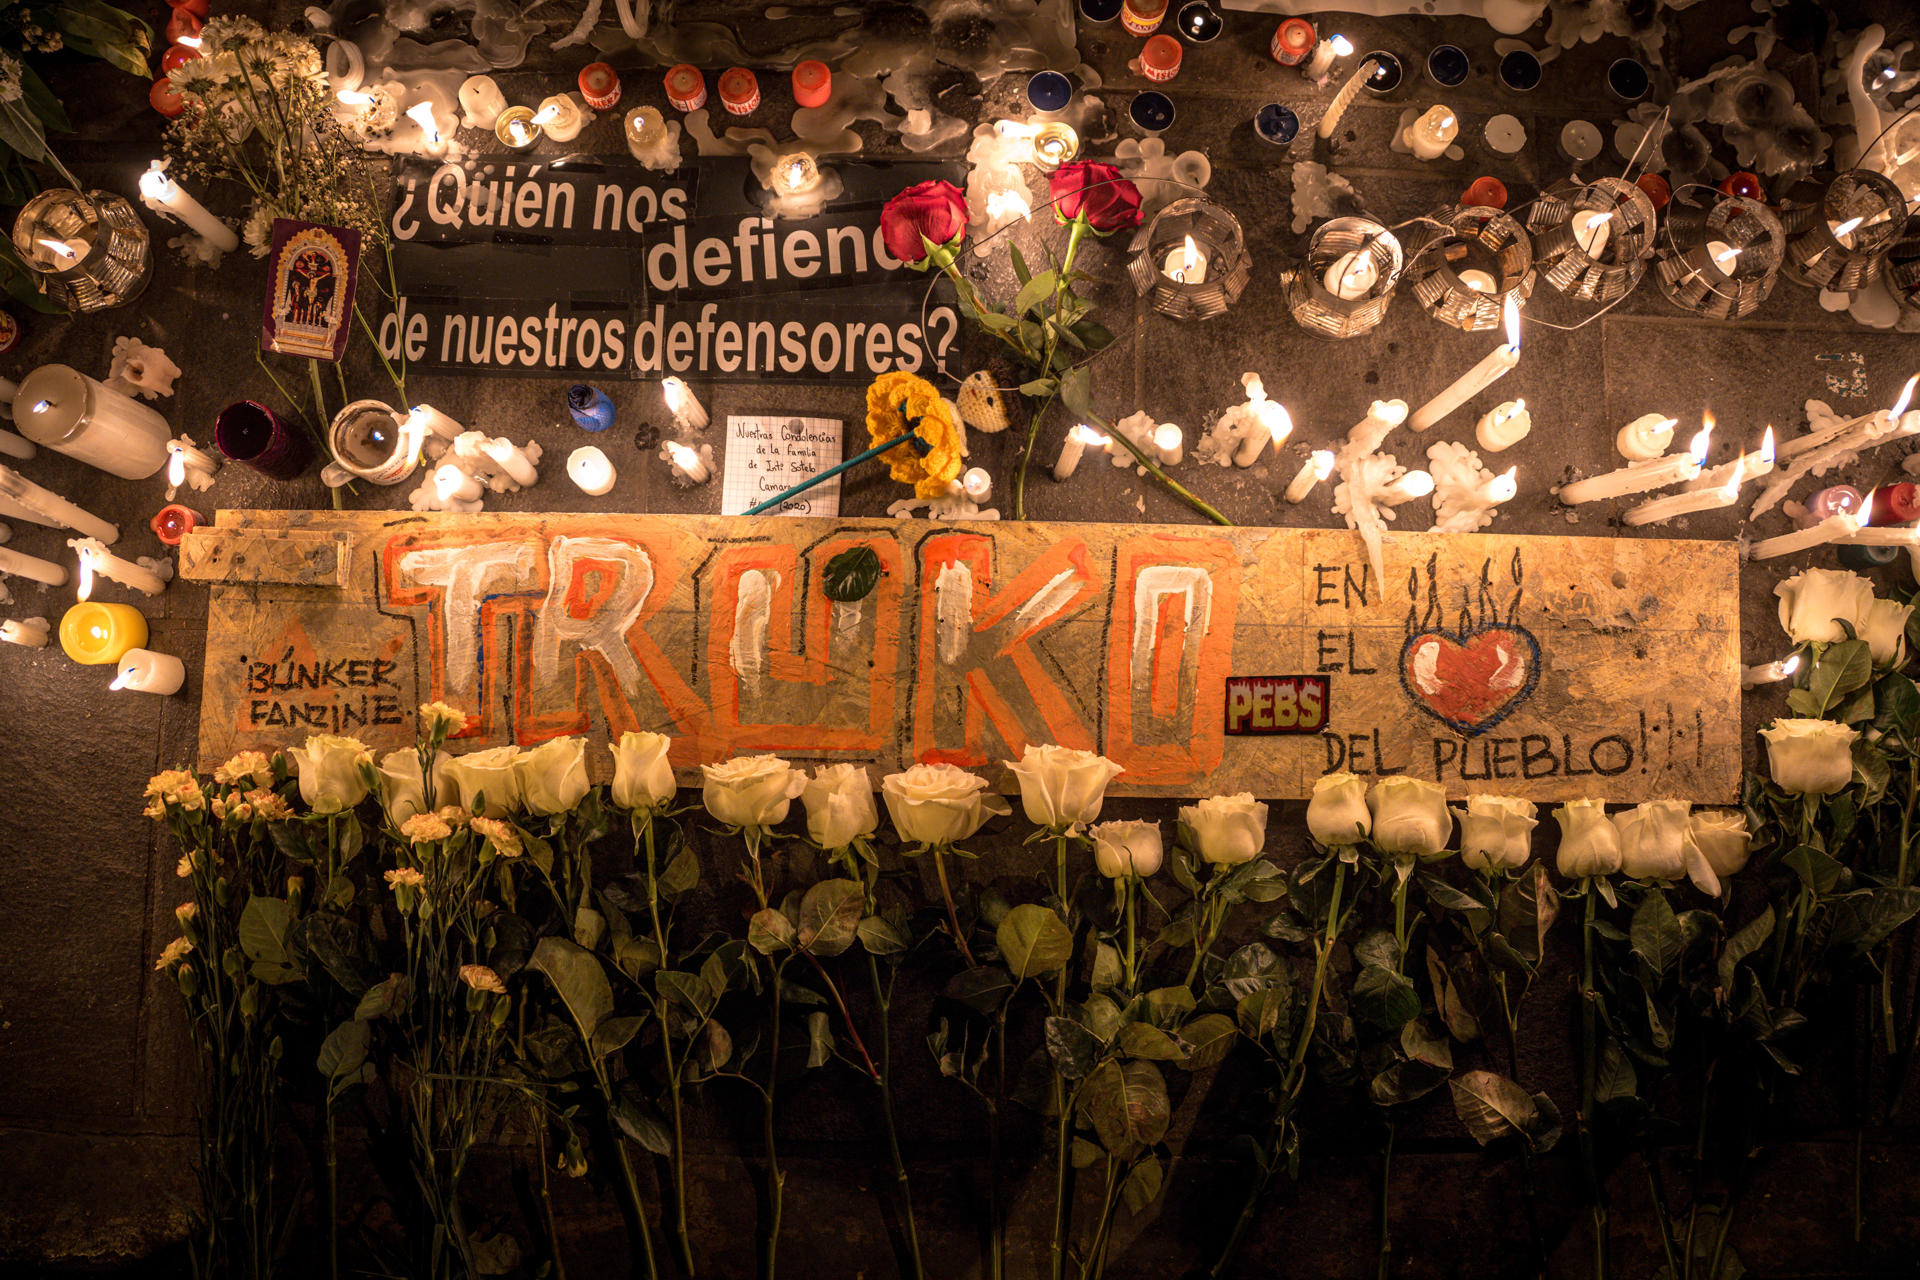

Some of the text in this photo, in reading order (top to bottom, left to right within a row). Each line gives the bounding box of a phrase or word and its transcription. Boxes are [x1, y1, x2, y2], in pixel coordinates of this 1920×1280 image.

[392, 162, 689, 241] ¿Quién nos
[647, 216, 907, 292] defien
[378, 296, 959, 374] de nuestros defensores?
[735, 422, 836, 443] Nuestras Condolencias
[756, 443, 766, 455] de
[748, 459, 758, 469] de
[759, 475, 797, 492] Camar
[780, 499, 812, 515] (2020)
[1312, 562, 1369, 608] EN
[248, 645, 402, 694] BÚNKER
[1316, 629, 1378, 676] EL
[1228, 677, 1323, 731] PEBS
[1321, 727, 1408, 777] DEL
